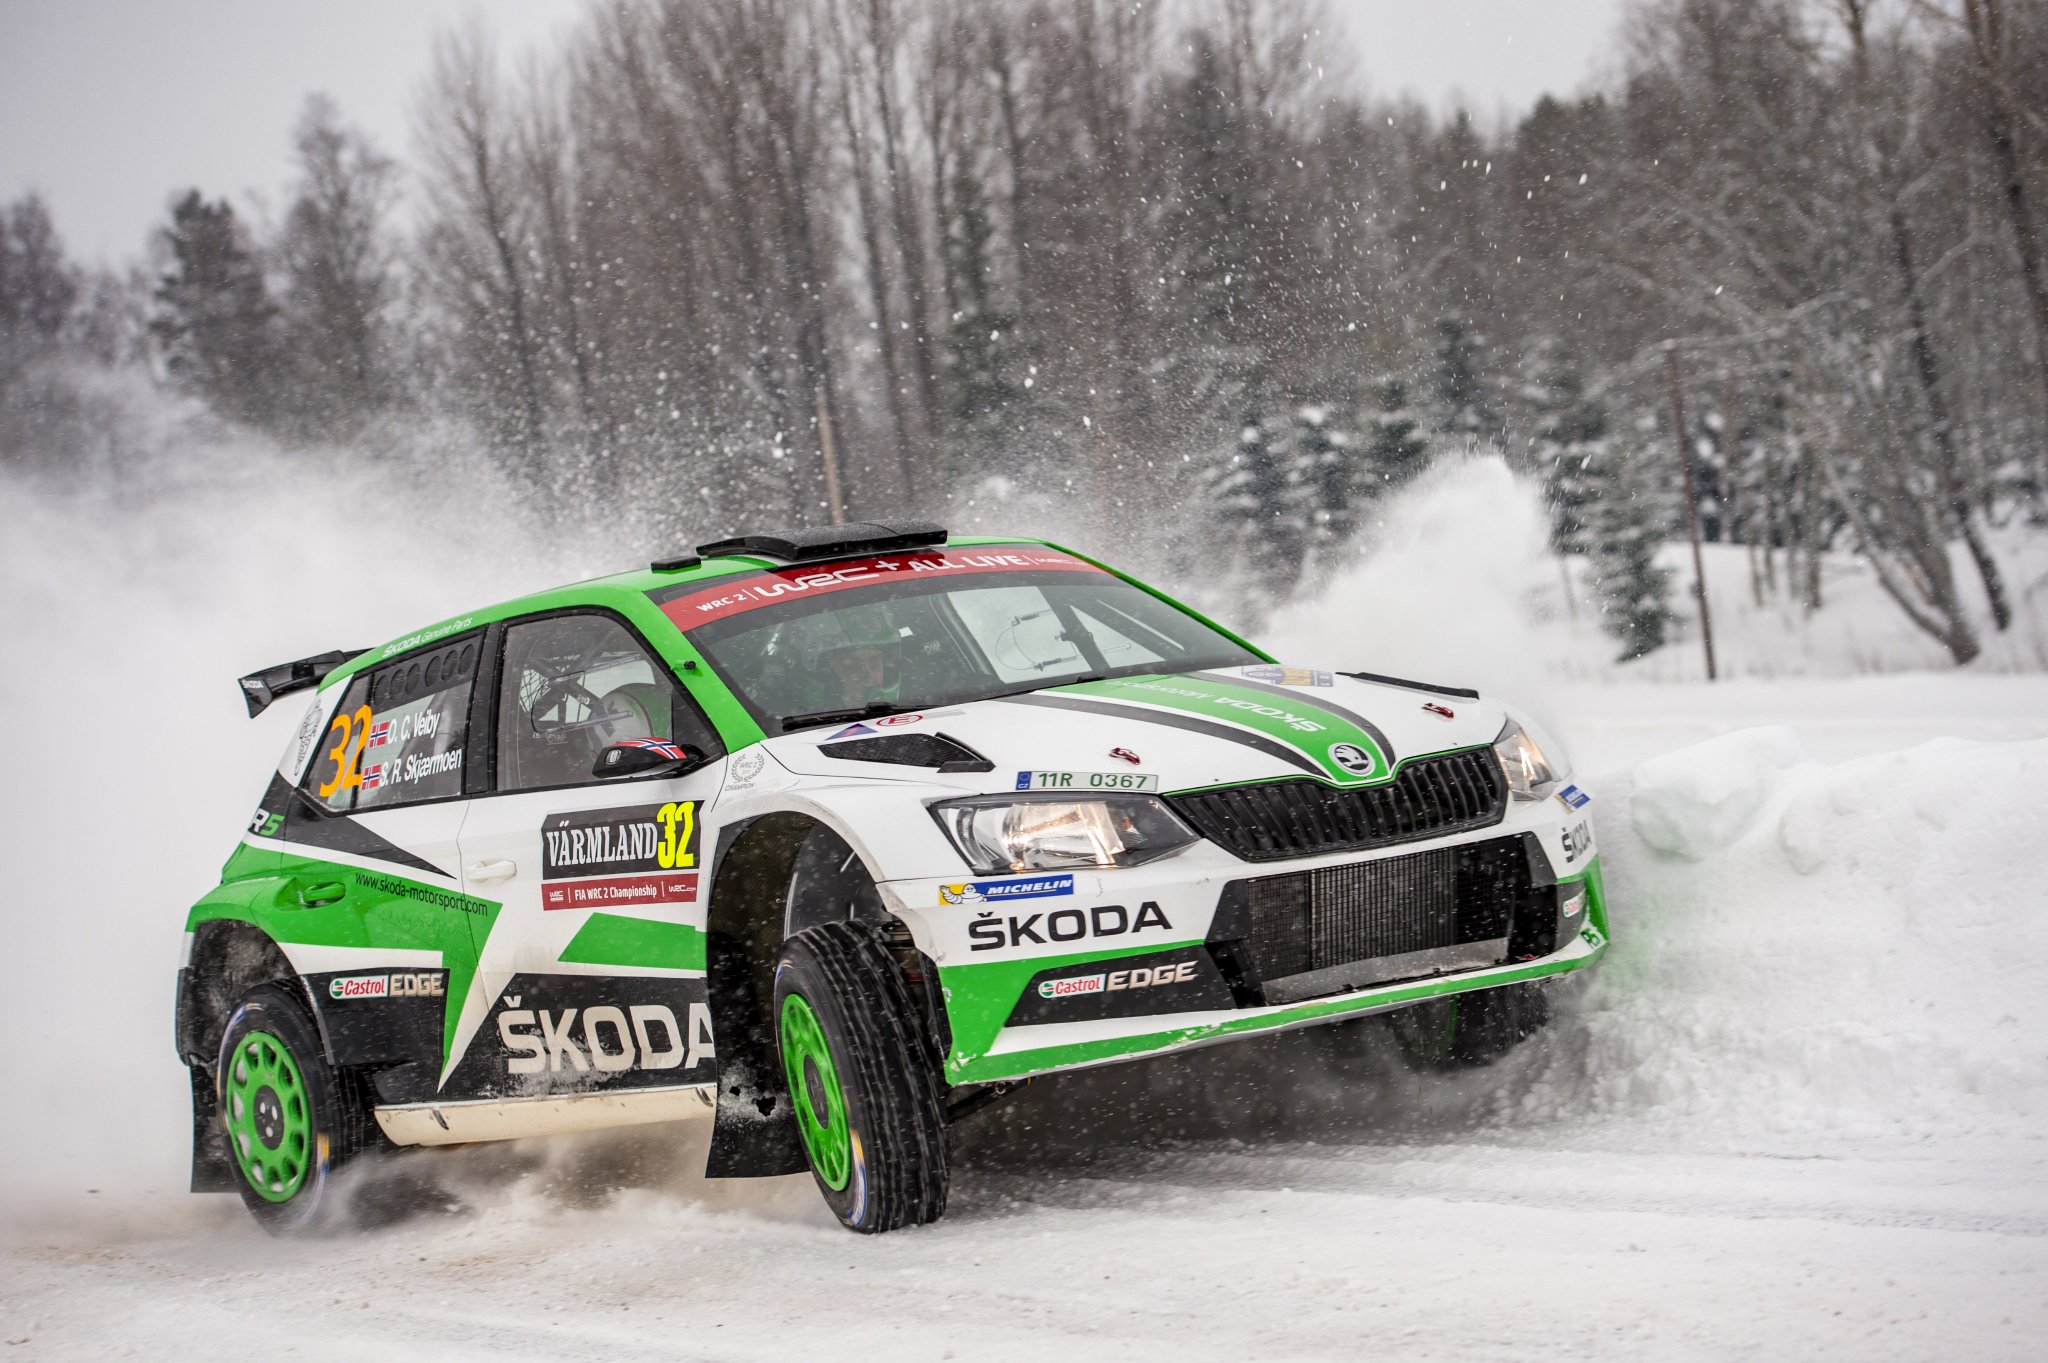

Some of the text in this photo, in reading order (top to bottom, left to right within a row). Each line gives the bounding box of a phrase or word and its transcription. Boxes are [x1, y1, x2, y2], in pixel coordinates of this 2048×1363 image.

[907, 558, 966, 572] ALL
[961, 555, 1031, 567] LIVE
[696, 593, 747, 612] WRC 2
[421, 623, 451, 642] Genuine
[451, 618, 473, 631] Parts
[387, 708, 441, 745] O. C. Veiby
[1213, 697, 1327, 732] ŠKODA
[319, 703, 372, 798] 32
[379, 748, 463, 788] S. R. Skjærmoen
[1038, 773, 1147, 789] 11R 0367
[252, 808, 285, 836] R5
[546, 801, 695, 869] VÄRMLAND 32
[355, 873, 488, 916] www.skoda-motorsport.com
[574, 889, 586, 900] FIA
[587, 887, 602, 899] WRC
[604, 886, 609, 898] 2
[610, 884, 657, 899] Championship
[987, 879, 1073, 895] MICHELIN
[968, 901, 1173, 951] ŠKODA
[344, 973, 445, 998] Castrol EDGE
[1055, 961, 1199, 995] Castrol EDGE
[497, 995, 716, 1074] ŠKODA
